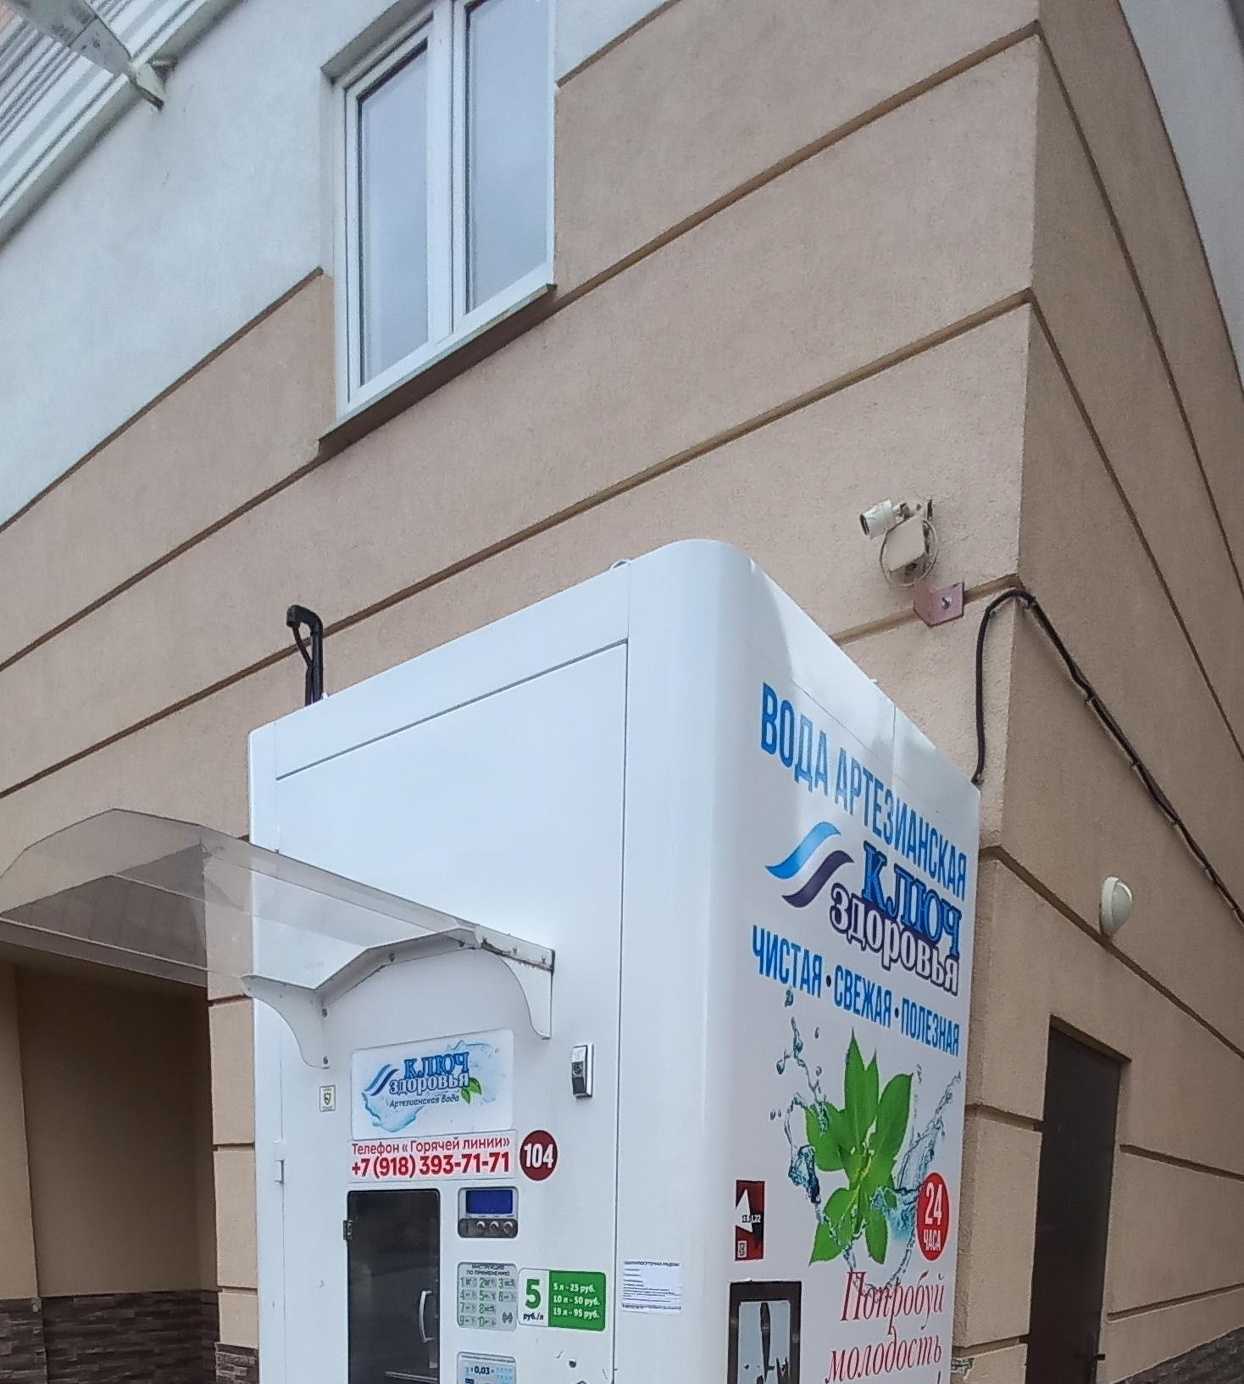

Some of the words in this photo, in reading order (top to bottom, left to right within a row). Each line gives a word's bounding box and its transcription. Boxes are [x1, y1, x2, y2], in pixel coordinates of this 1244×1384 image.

[760, 682, 829, 796] ВОДА
[834, 747, 967, 902] АРТЕЗИАНСКАЯ
[861, 841, 963, 958] КЛЮЧ
[752, 924, 822, 998] ЧИСТАЯ
[834, 964, 891, 1028] СВЕЖАЯ
[901, 998, 960, 1057] ПОЛЕЗНАЯ
[403, 1051, 469, 1079] КЛЮЧ
[352, 1141, 399, 1156] Телефон
[463, 1137, 510, 1149] линии»
[523, 1143, 554, 1169] 104
[352, 1158, 371, 1177] +7
[373, 1155, 416, 1179] (918)
[419, 1152, 510, 1175] 393-71-71
[925, 1182, 943, 1226] 24
[923, 1229, 942, 1251] ЧАСА
[525, 1279, 541, 1309] 5
[553, 1295, 562, 1303] 10
[574, 1296, 583, 1304] 50
[570, 1283, 579, 1291] 25
[573, 1308, 582, 1317] 95
[840, 1270, 945, 1335] Попробуй
[825, 1326, 942, 1384] молодость
